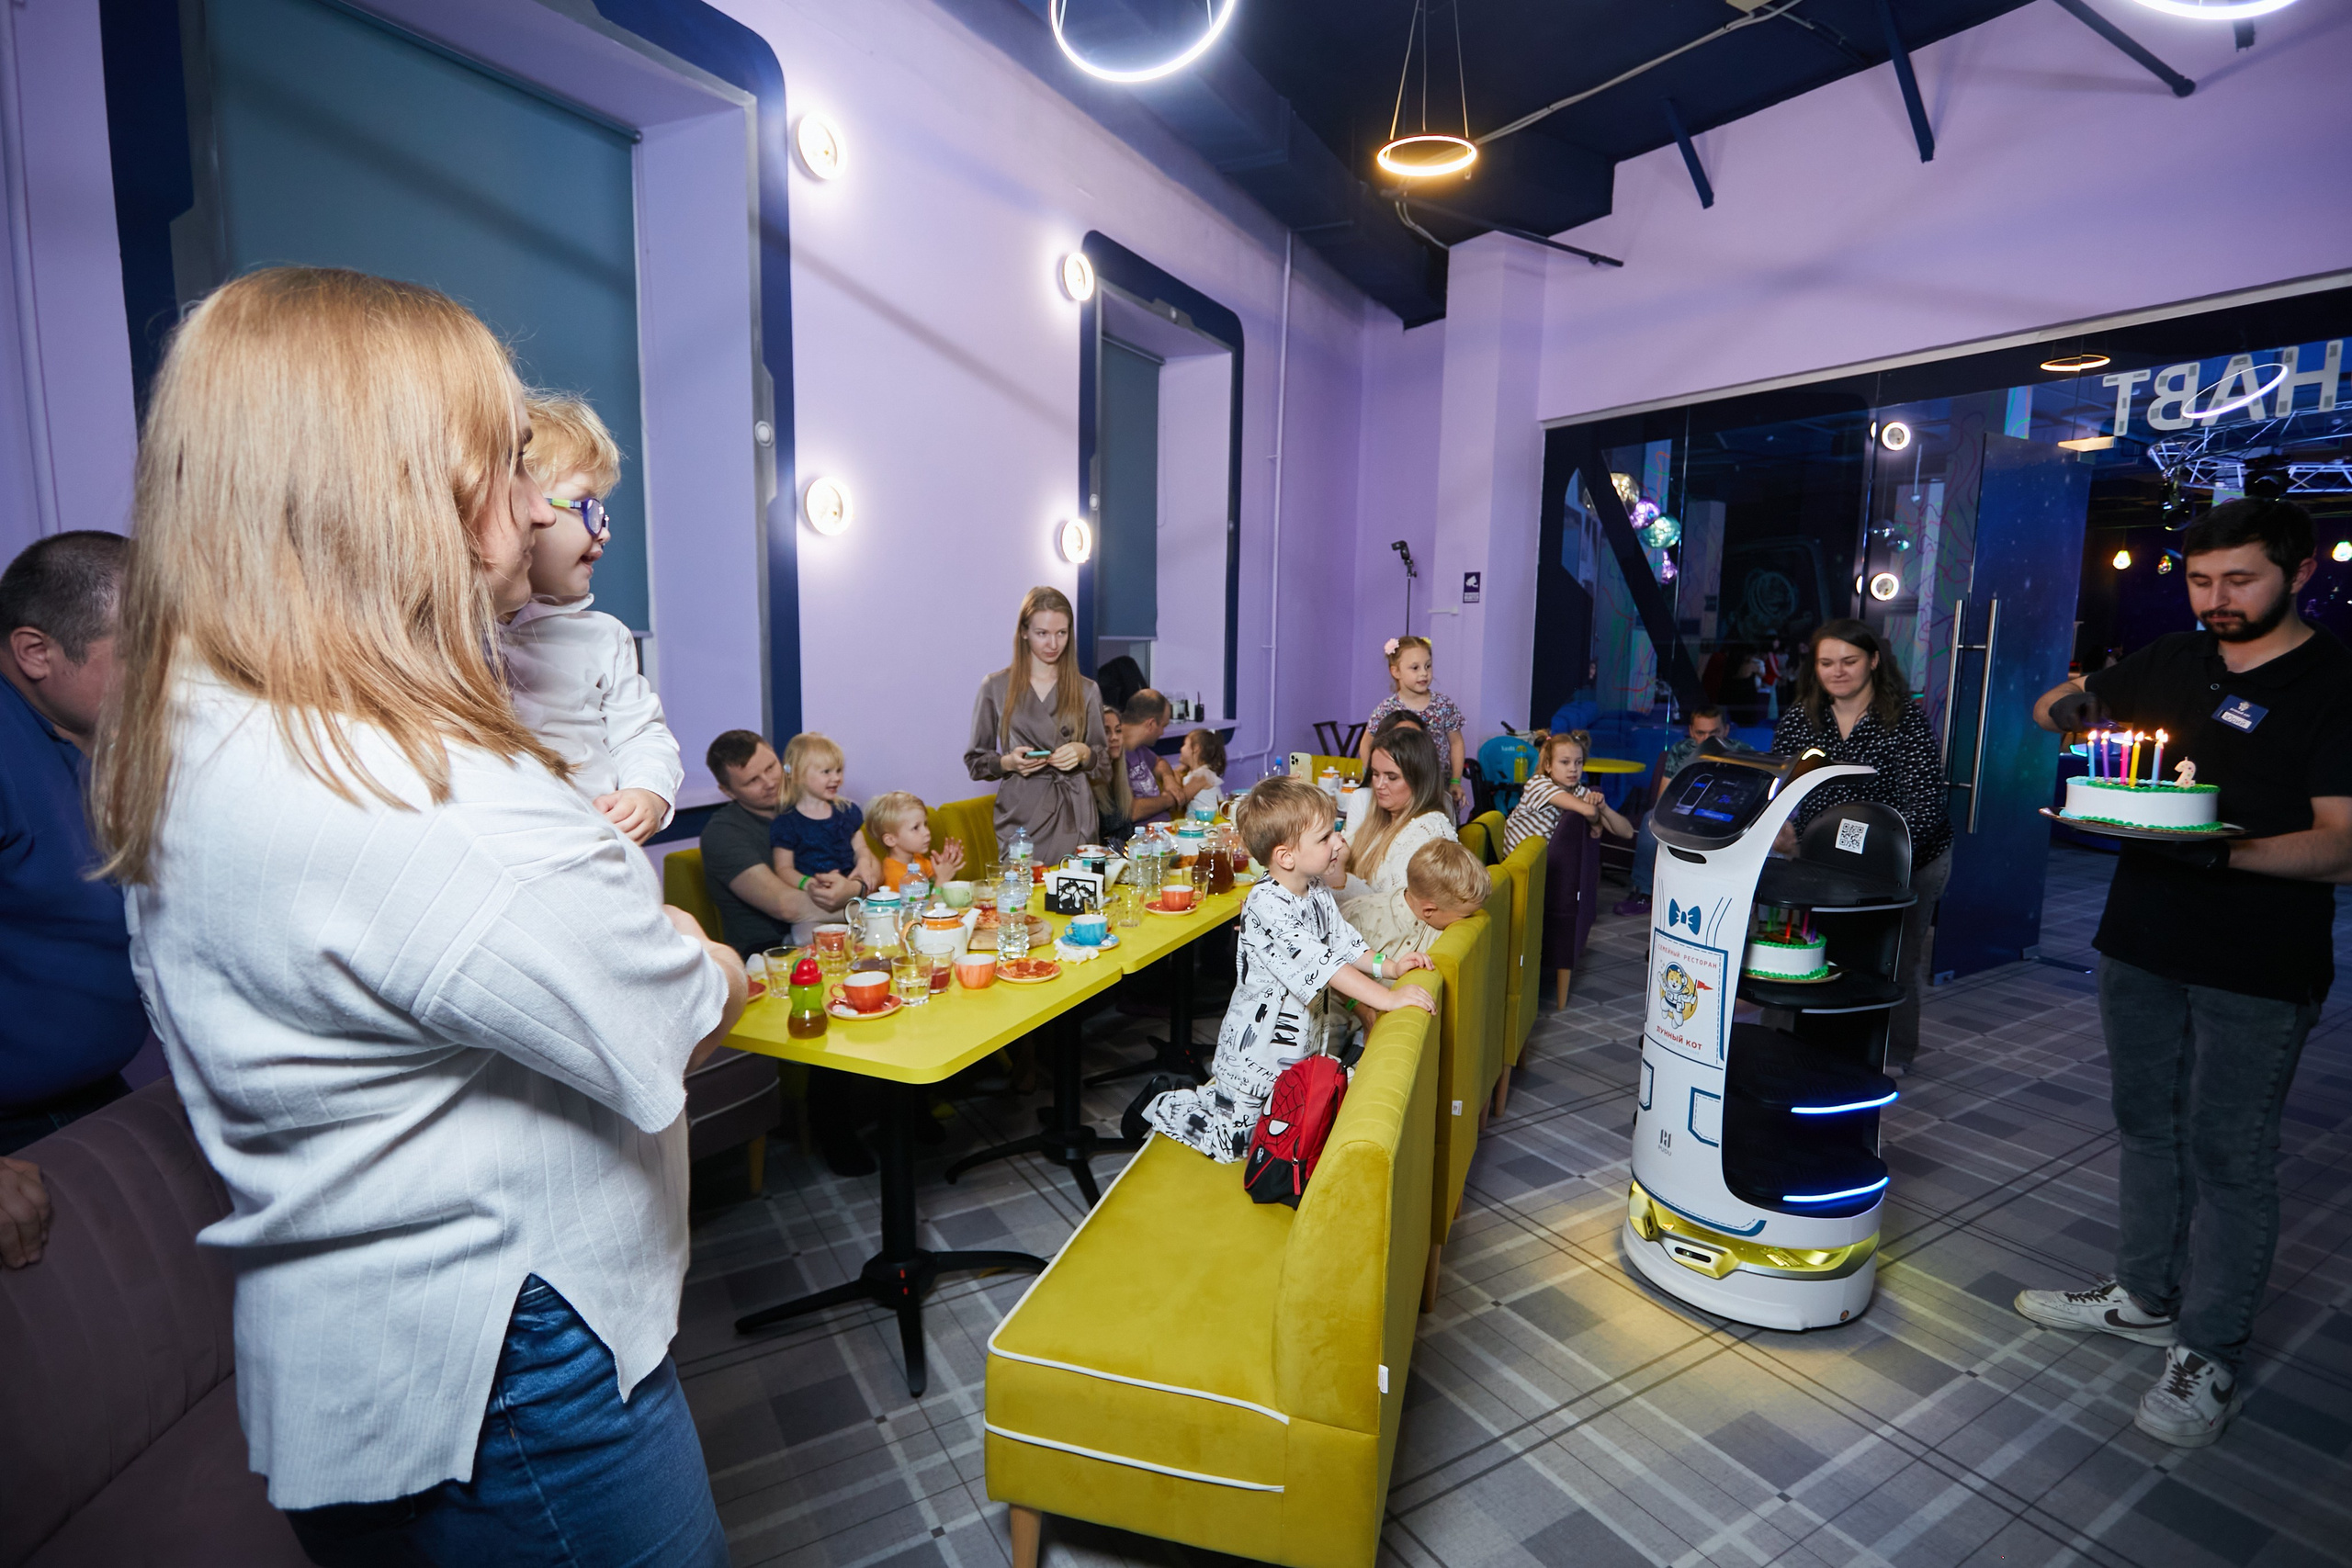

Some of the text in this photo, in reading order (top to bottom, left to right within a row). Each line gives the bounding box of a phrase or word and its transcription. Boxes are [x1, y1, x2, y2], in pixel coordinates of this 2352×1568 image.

[1657, 943, 1717, 968] СЕМЕЙНЫЙ РЕСТОРАН
[1657, 1025, 1683, 1043] ЛУННЫЙ
[1686, 1039, 1702, 1050] КОТ
